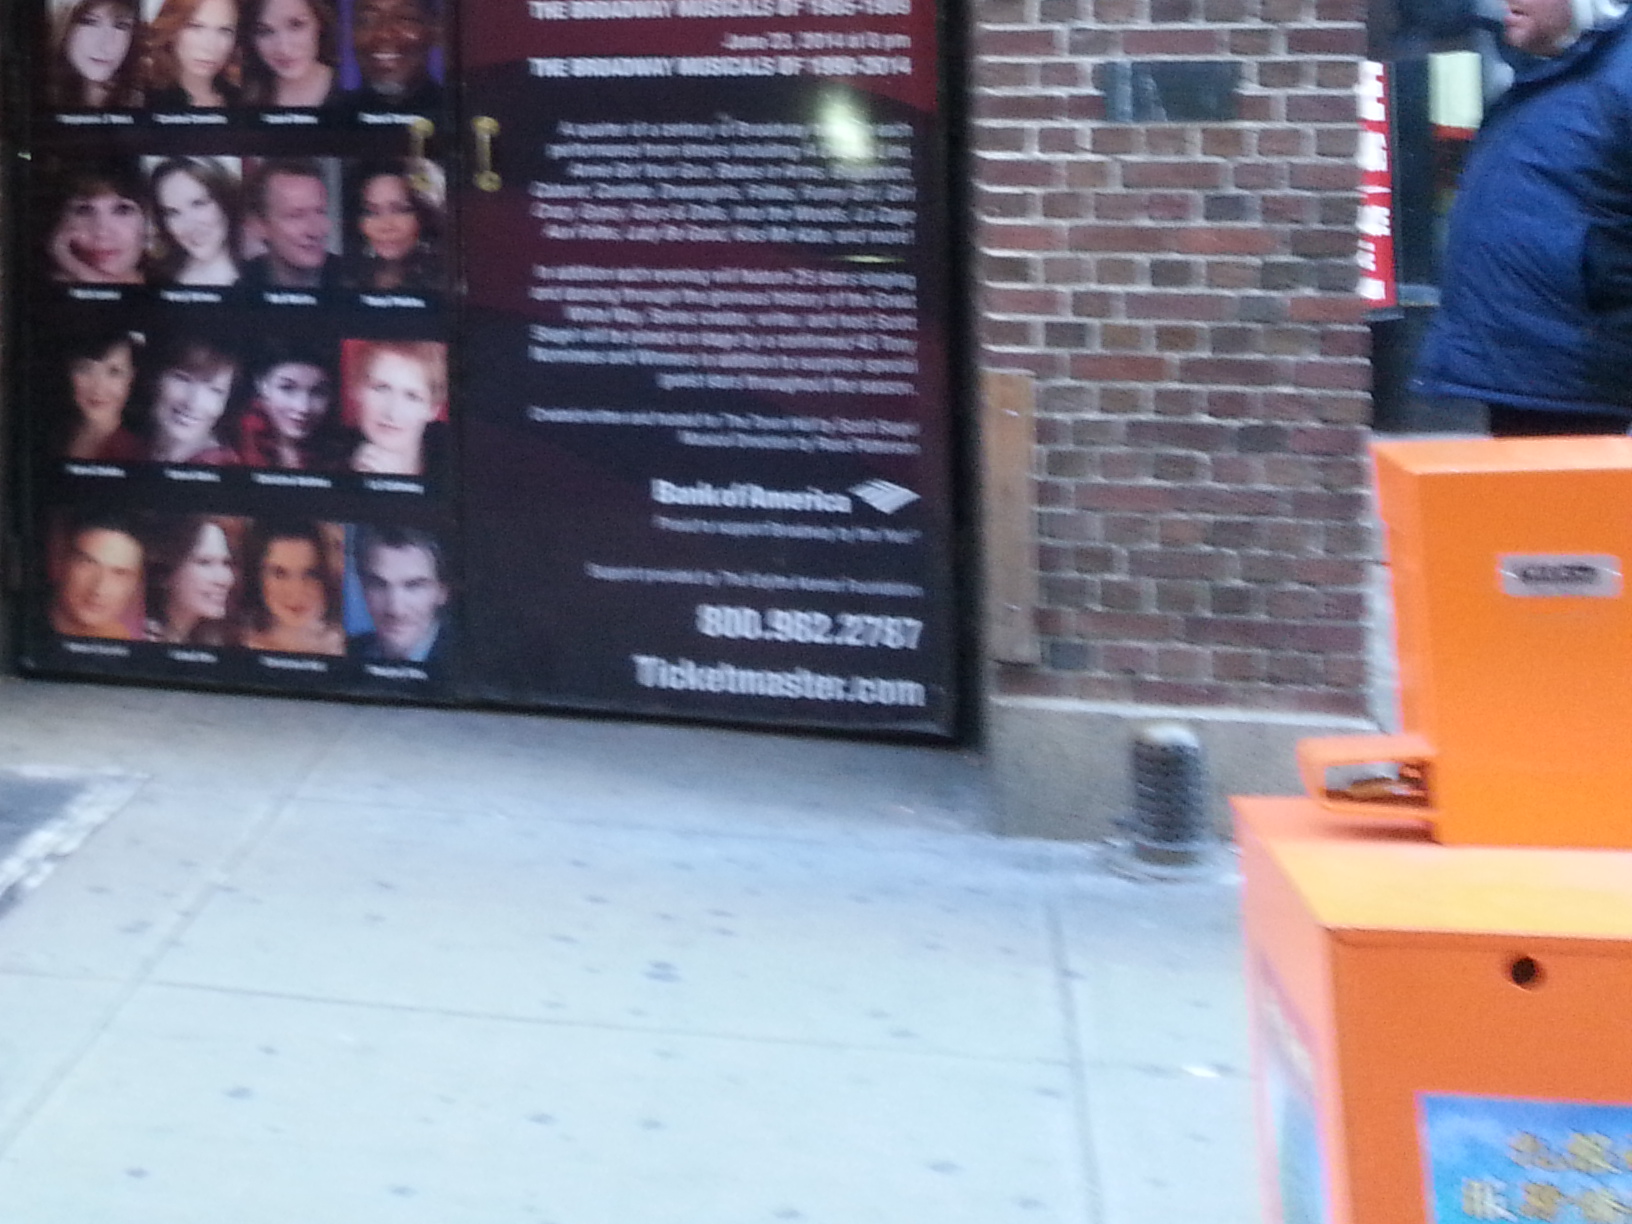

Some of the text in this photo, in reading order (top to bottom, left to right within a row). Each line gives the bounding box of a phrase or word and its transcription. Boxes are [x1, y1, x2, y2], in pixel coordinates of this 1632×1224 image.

[568, 0, 671, 19] BROADWAY
[569, 57, 672, 77] BROADWAY
[676, 57, 775, 76] MUSICALS
[650, 479, 721, 506] Bank
[748, 483, 852, 513] America
[632, 654, 926, 707] Ticketmaster.com
